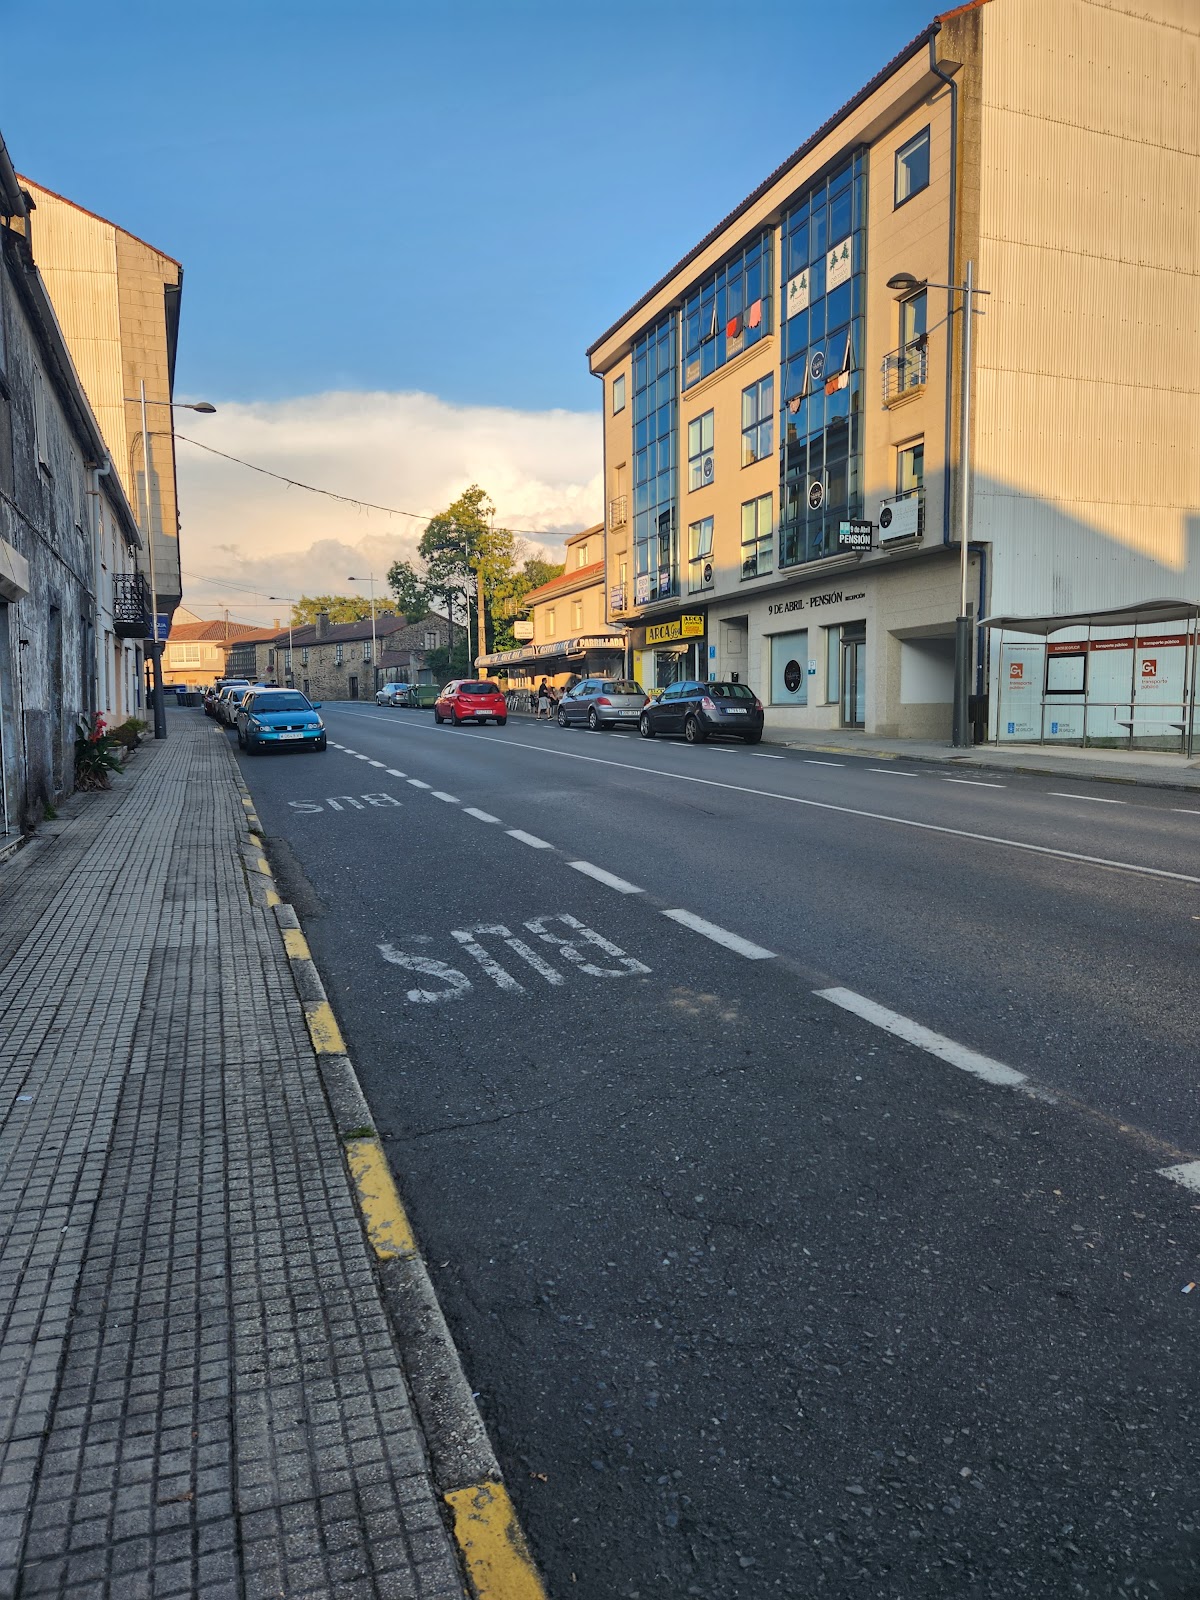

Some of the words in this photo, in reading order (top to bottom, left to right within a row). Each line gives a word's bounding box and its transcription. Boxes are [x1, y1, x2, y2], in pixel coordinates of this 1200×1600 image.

[860, 525, 871, 534] Abril
[839, 533, 871, 545] PENSIÓN
[768, 605, 773, 615] 9
[774, 603, 783, 614] DE
[784, 599, 804, 612] ABRIL
[809, 591, 843, 607] PENSIÓN
[649, 625, 671, 641] ARCA
[580, 637, 624, 647] PARRILLADA
[288, 793, 403, 813] BUS
[376, 913, 652, 1003] BUS
